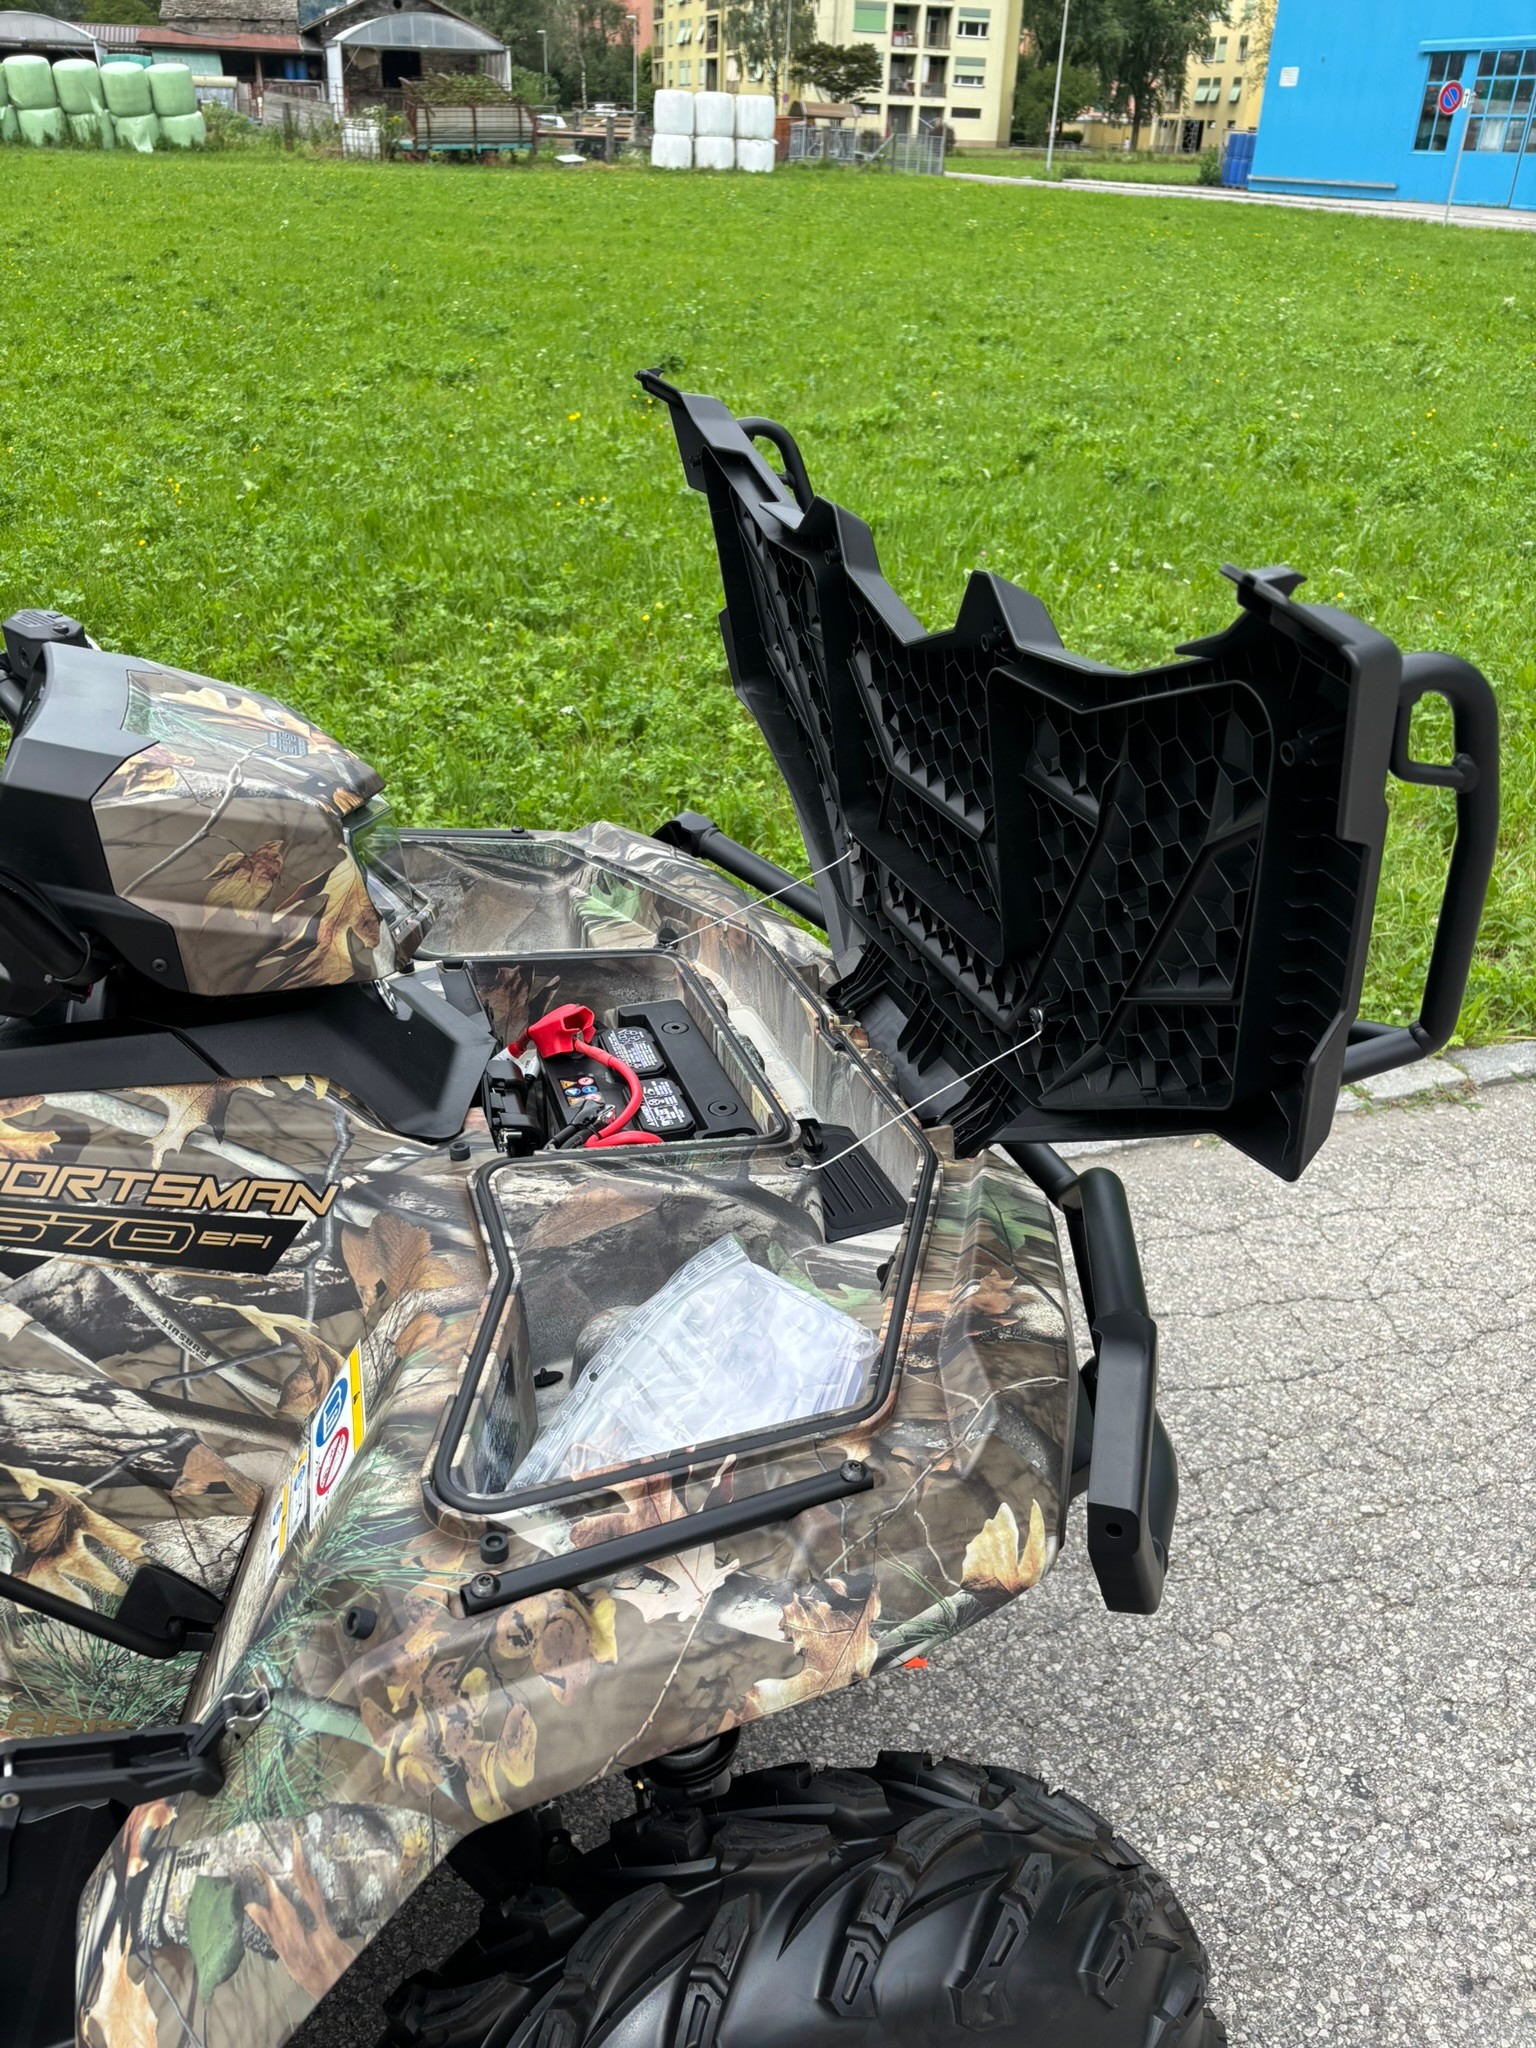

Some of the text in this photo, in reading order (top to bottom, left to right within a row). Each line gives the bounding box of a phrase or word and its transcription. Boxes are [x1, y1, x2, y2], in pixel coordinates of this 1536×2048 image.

[0, 1161, 341, 1217] ORTSMAN
[197, 1230, 273, 1249] EFI
[161, 1318, 212, 1359] PURSUIT
